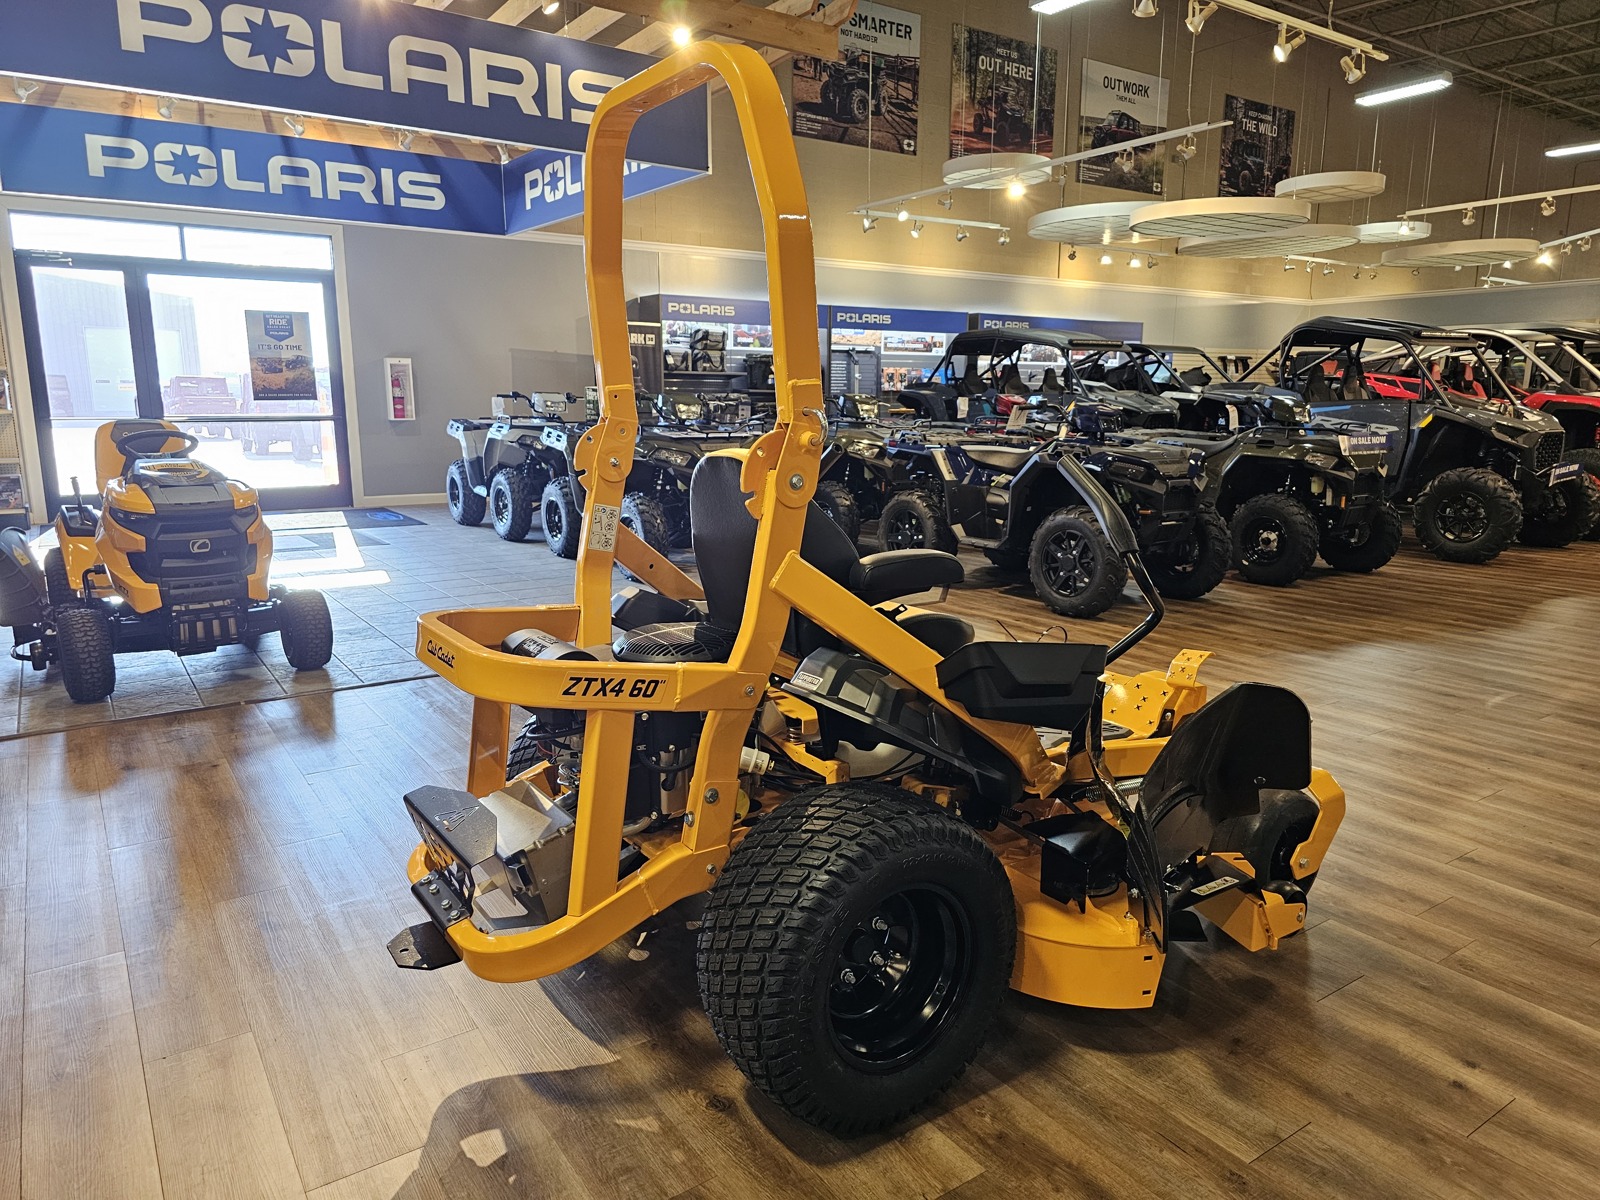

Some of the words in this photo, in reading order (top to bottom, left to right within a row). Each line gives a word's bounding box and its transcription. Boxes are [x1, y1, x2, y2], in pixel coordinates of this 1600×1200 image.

[849, 12, 913, 40] SMARTER
[840, 28, 853, 37] NOT
[854, 32, 878, 43] HARDER
[996, 47, 1010, 57] MEET
[1010, 51, 1018, 59] US
[117, 0, 625, 125] POLARIS
[978, 55, 1002, 72] OUT
[1004, 61, 1034, 80] HERE
[1103, 76, 1150, 98] OUTWORK
[1116, 94, 1127, 103] THEM
[1241, 118, 1257, 132] THE
[1259, 121, 1278, 137] WILD
[84, 133, 446, 211] POLARIS
[667, 302, 735, 316] POLARIS
[269, 318, 288, 326] RIDE
[836, 312, 892, 324] POLARIS
[983, 319, 1029, 329] POLARIS
[1358, 436, 1371, 444] SALE
[1371, 435, 1387, 444] NOW
[426, 640, 438, 657] Cub
[437, 646, 456, 668] Cadet
[562, 677, 627, 697] ZTX4
[628, 679, 667, 698] 60"
